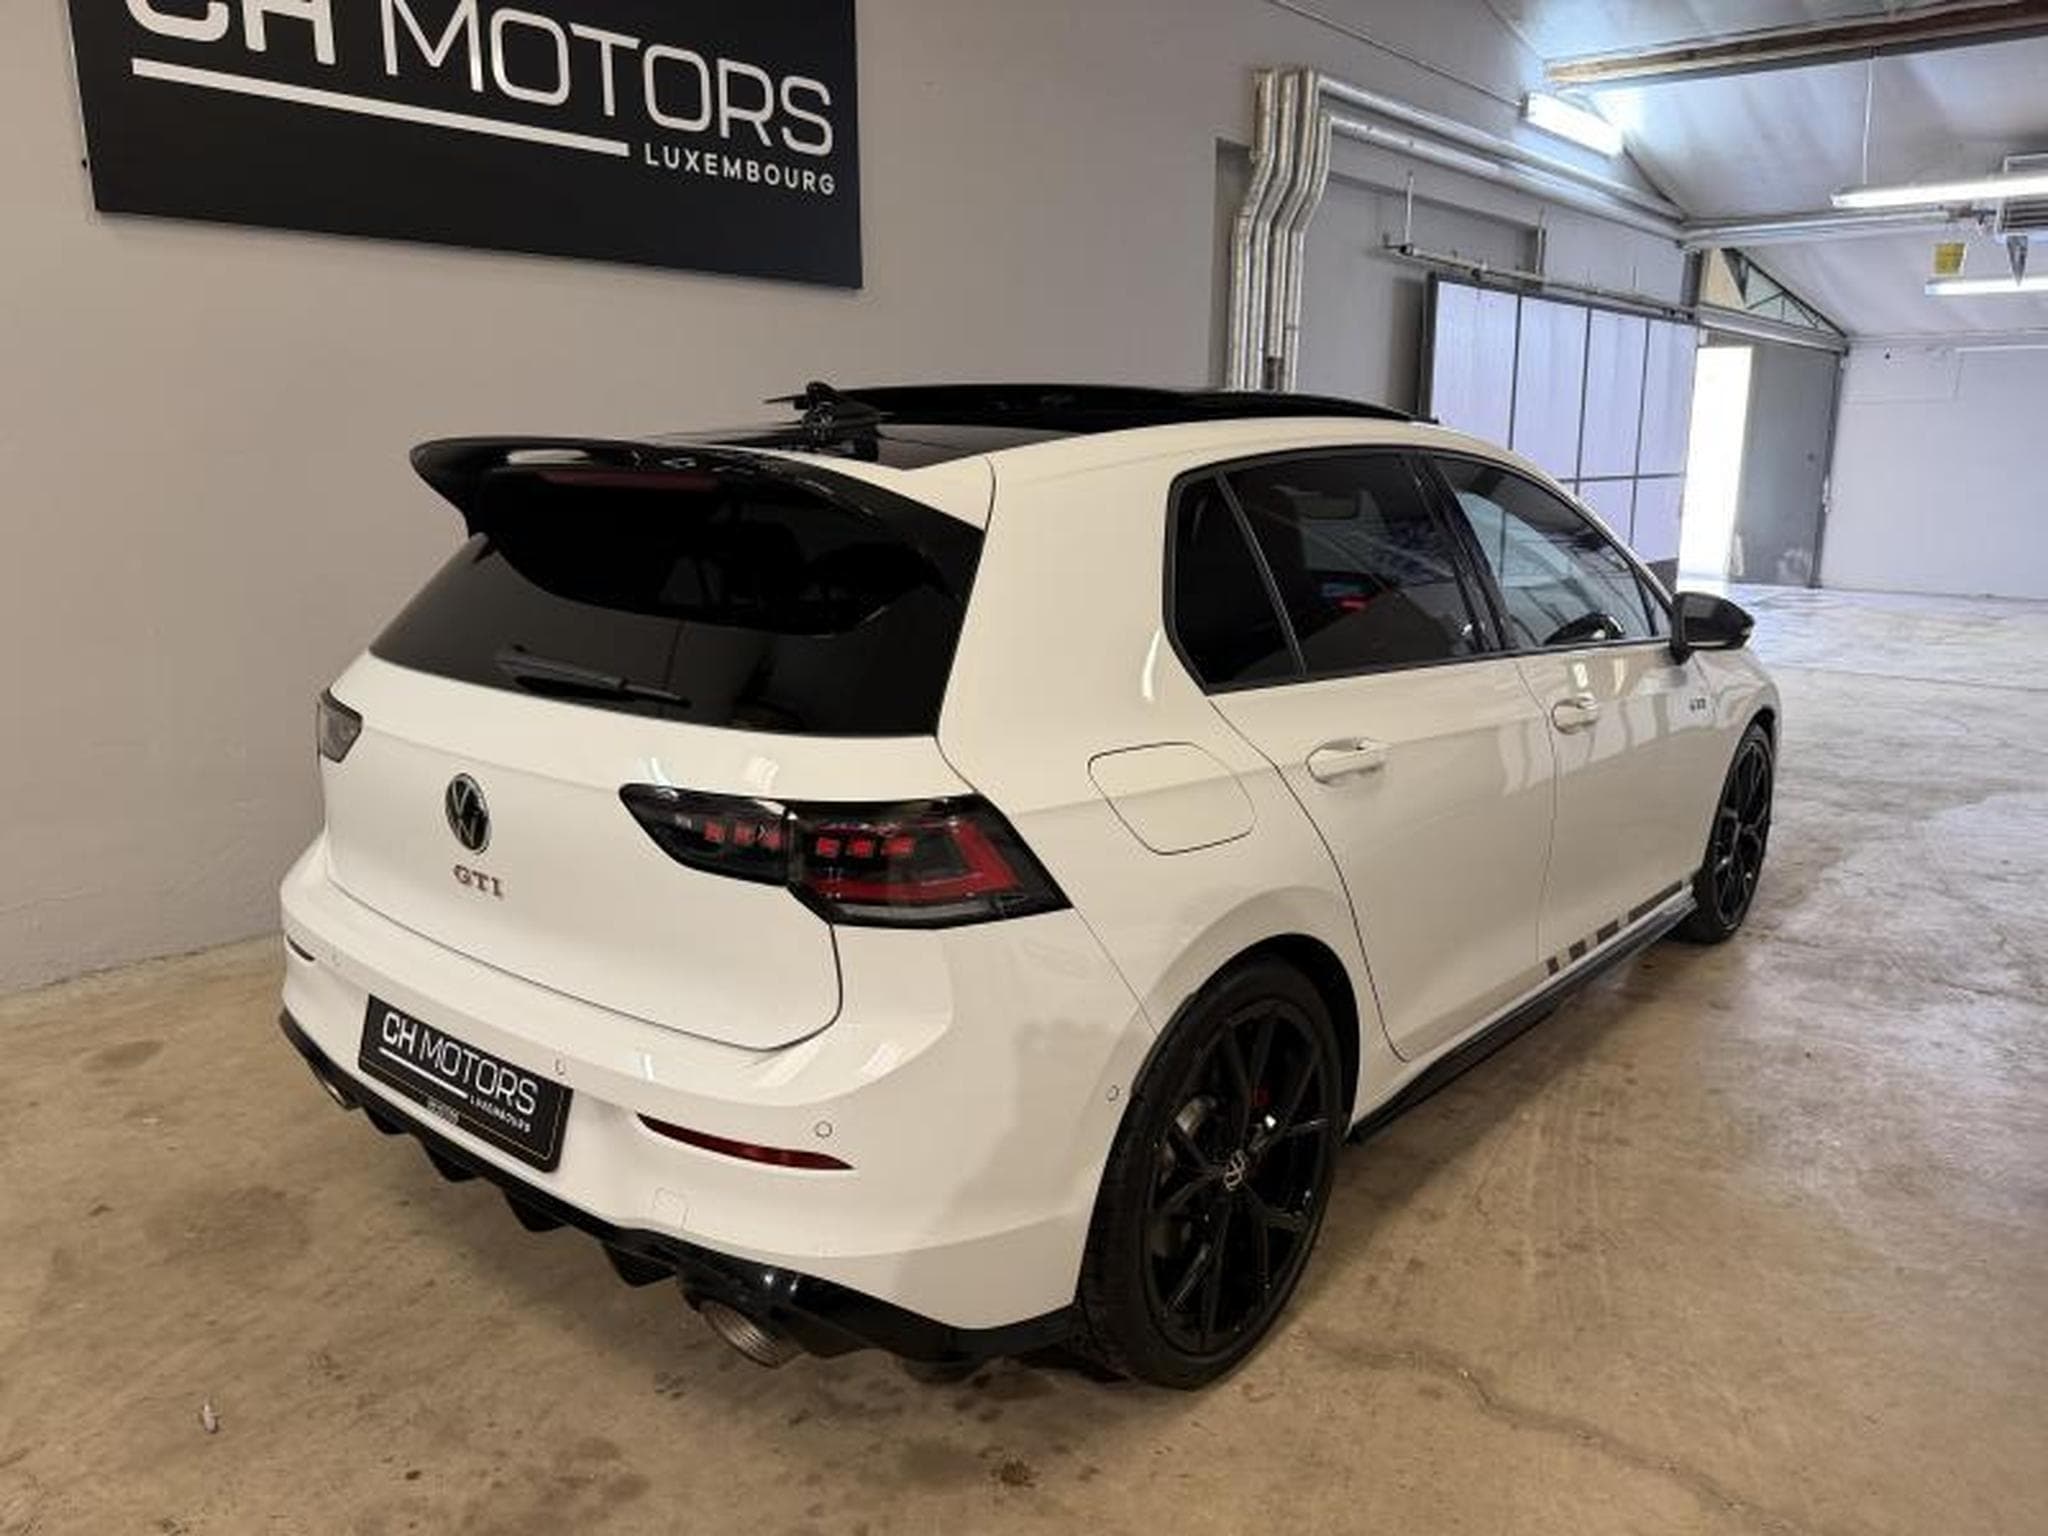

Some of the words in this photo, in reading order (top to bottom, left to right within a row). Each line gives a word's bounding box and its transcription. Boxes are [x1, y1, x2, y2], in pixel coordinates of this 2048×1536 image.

[381, 0, 834, 156] MOTORS
[644, 142, 836, 196] LUXEMBOURG
[453, 863, 505, 899] GTI
[382, 1011, 419, 1055] CH
[419, 1028, 538, 1116] MOTORS
